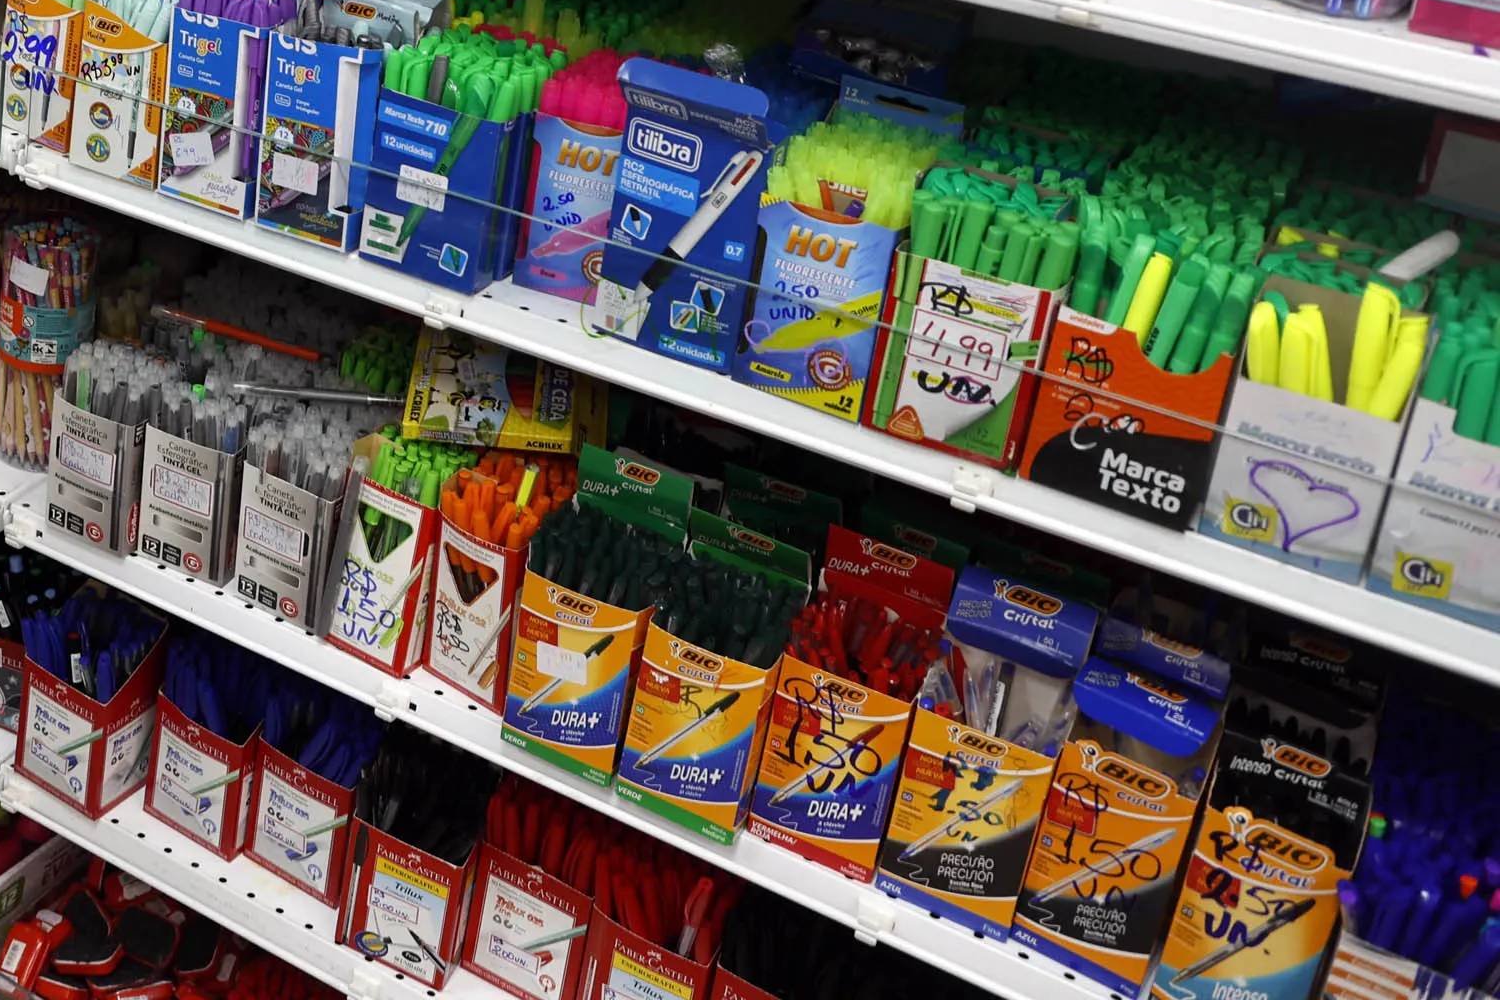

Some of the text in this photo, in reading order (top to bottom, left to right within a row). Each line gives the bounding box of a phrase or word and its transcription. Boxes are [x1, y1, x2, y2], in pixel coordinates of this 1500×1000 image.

[179, 29, 222, 56] Trigel
[276, 56, 321, 84] Trigel
[182, 100, 192, 109] 12
[633, 88, 683, 116] tilibra
[384, 107, 447, 136] Marca Texto 710
[279, 129, 289, 139] 12
[636, 125, 691, 164] tilibra
[556, 138, 621, 176] HOT
[623, 158, 645, 173] RC2
[621, 177, 661, 199] RETRÁTIL
[622, 169, 695, 201] ESFEROGRÁFICA
[726, 245, 743, 256] 0.7
[784, 224, 858, 269] HOT
[774, 258, 856, 289] FLUORESCENTE
[923, 321, 994, 372] 4,99
[756, 363, 785, 380] Amarelo
[410, 389, 424, 423] ACRILEX
[550, 368, 570, 421] DE CERA
[838, 395, 854, 408] 12
[70, 410, 96, 428] Caneta
[824, 401, 851, 414] unidades
[61, 415, 108, 441] Esferográfica
[64, 426, 102, 446] TINTA GEL
[1237, 421, 1311, 455] Marca
[169, 440, 197, 458] Caneta
[526, 440, 564, 450] ACRILEX
[157, 443, 209, 471] Esferográfica
[1100, 447, 1186, 494] Marca
[267, 483, 296, 501] Caneta
[622, 481, 655, 495] Cristal
[1098, 467, 1181, 514] Texto
[255, 486, 307, 517] Esferográfica
[871, 562, 912, 578] Cristal
[1005, 586, 1060, 614] BIC
[1003, 608, 1058, 630] Cristal
[681, 650, 720, 671] BIC
[677, 664, 718, 682] Cristal
[29, 672, 96, 722] FABER-CASTELL
[551, 709, 601, 728] DURA+
[161, 711, 231, 765] FABER-CASTELL
[503, 732, 527, 749] VERDE
[1230, 755, 1271, 775] Intenso
[1278, 750, 1326, 774] BIC
[670, 764, 724, 785] DURA+
[1101, 763, 1167, 795] BIC
[1274, 768, 1326, 790] Cristal
[618, 785, 643, 801] VERDE
[1057, 771, 1110, 814] R$
[807, 800, 865, 821] DURA+
[750, 820, 797, 846] VERMELHA/
[750, 827, 772, 842] ROJA
[940, 851, 995, 870] PRECISÃO
[1250, 831, 1323, 869] BIC
[377, 843, 452, 888] FABER-CASTELL
[382, 861, 441, 896] ESFEROGRÁFICA
[489, 859, 579, 914] FABER-CASTELL
[394, 881, 424, 903] Trilux
[1076, 903, 1127, 922] PRECISÃO
[1015, 929, 1038, 946] AZUL
[613, 937, 695, 988] FABER-CASTELL
[620, 957, 683, 995] ESFEROGRÁFICA
[632, 979, 663, 1000] Trilux
